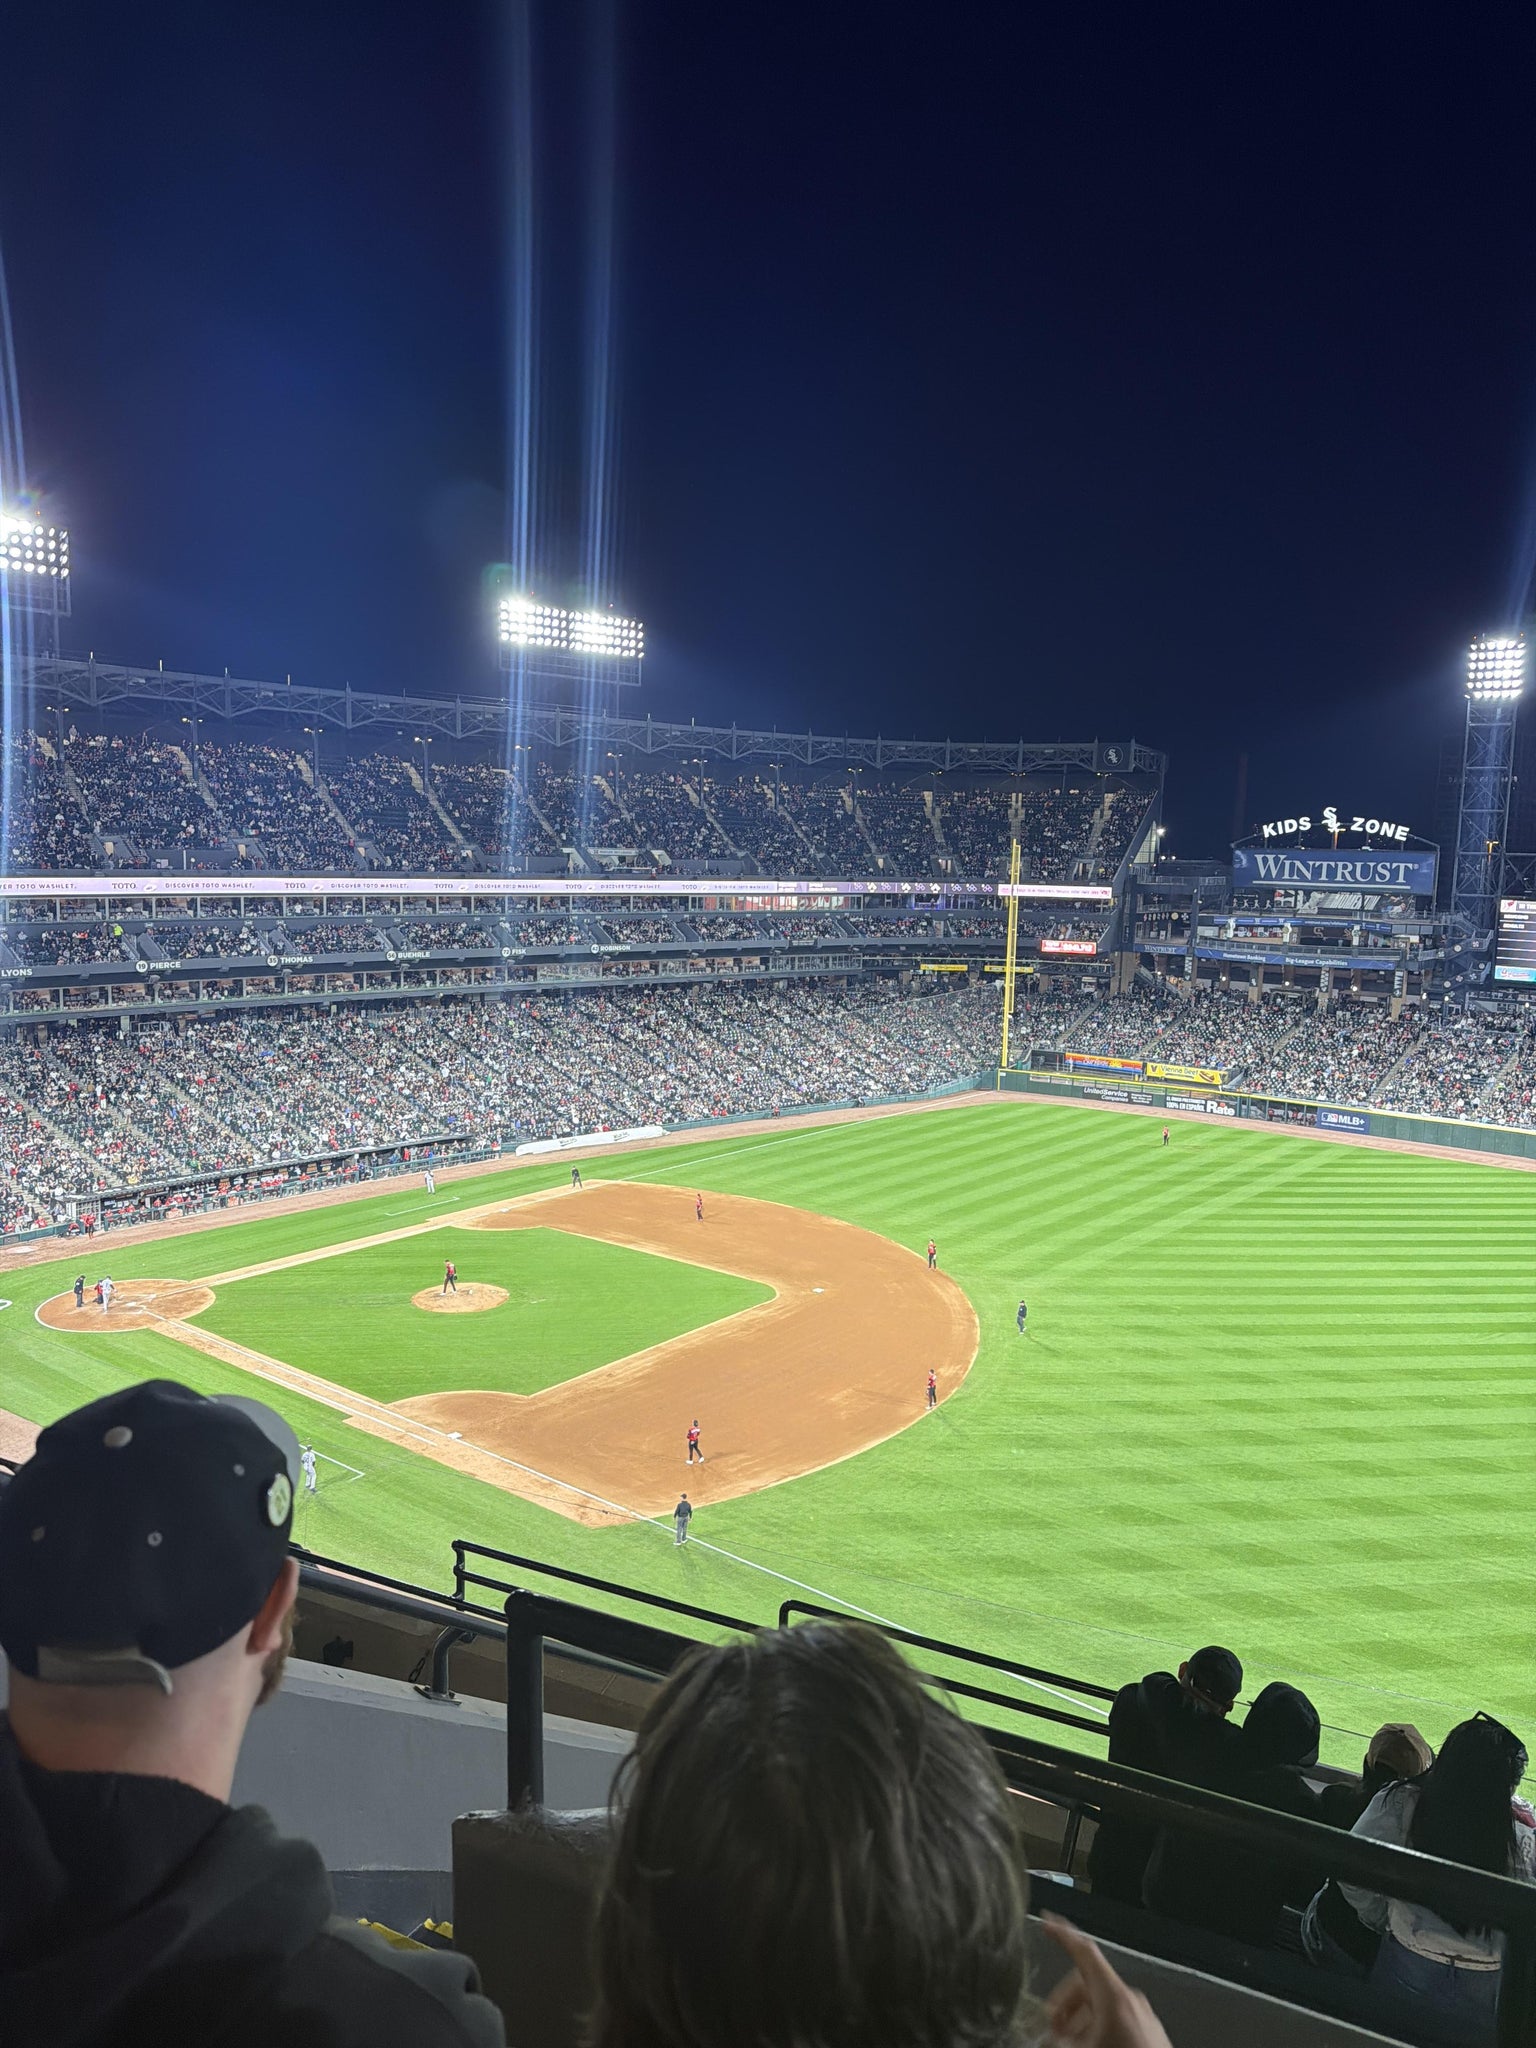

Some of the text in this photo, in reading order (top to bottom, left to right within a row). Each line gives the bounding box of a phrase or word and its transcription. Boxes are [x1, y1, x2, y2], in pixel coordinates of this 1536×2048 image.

[1262, 816, 1312, 838] KIDS
[1350, 816, 1410, 841] ZONE
[1254, 854, 1414, 883] WINTRUST
[112, 882, 137, 890] TOTO
[279, 956, 314, 964] THOMAS
[397, 951, 431, 960] BUEHRLE
[149, 961, 182, 970] PIERCE
[1285, 957, 1315, 965] Big-League
[1, 968, 33, 977] LYONS
[1161, 1064, 1184, 1074] Vienna
[1101, 1095, 1129, 1103] Companies
[1206, 1100, 1236, 1116] Rate
[1338, 1114, 1366, 1126] MLB+
